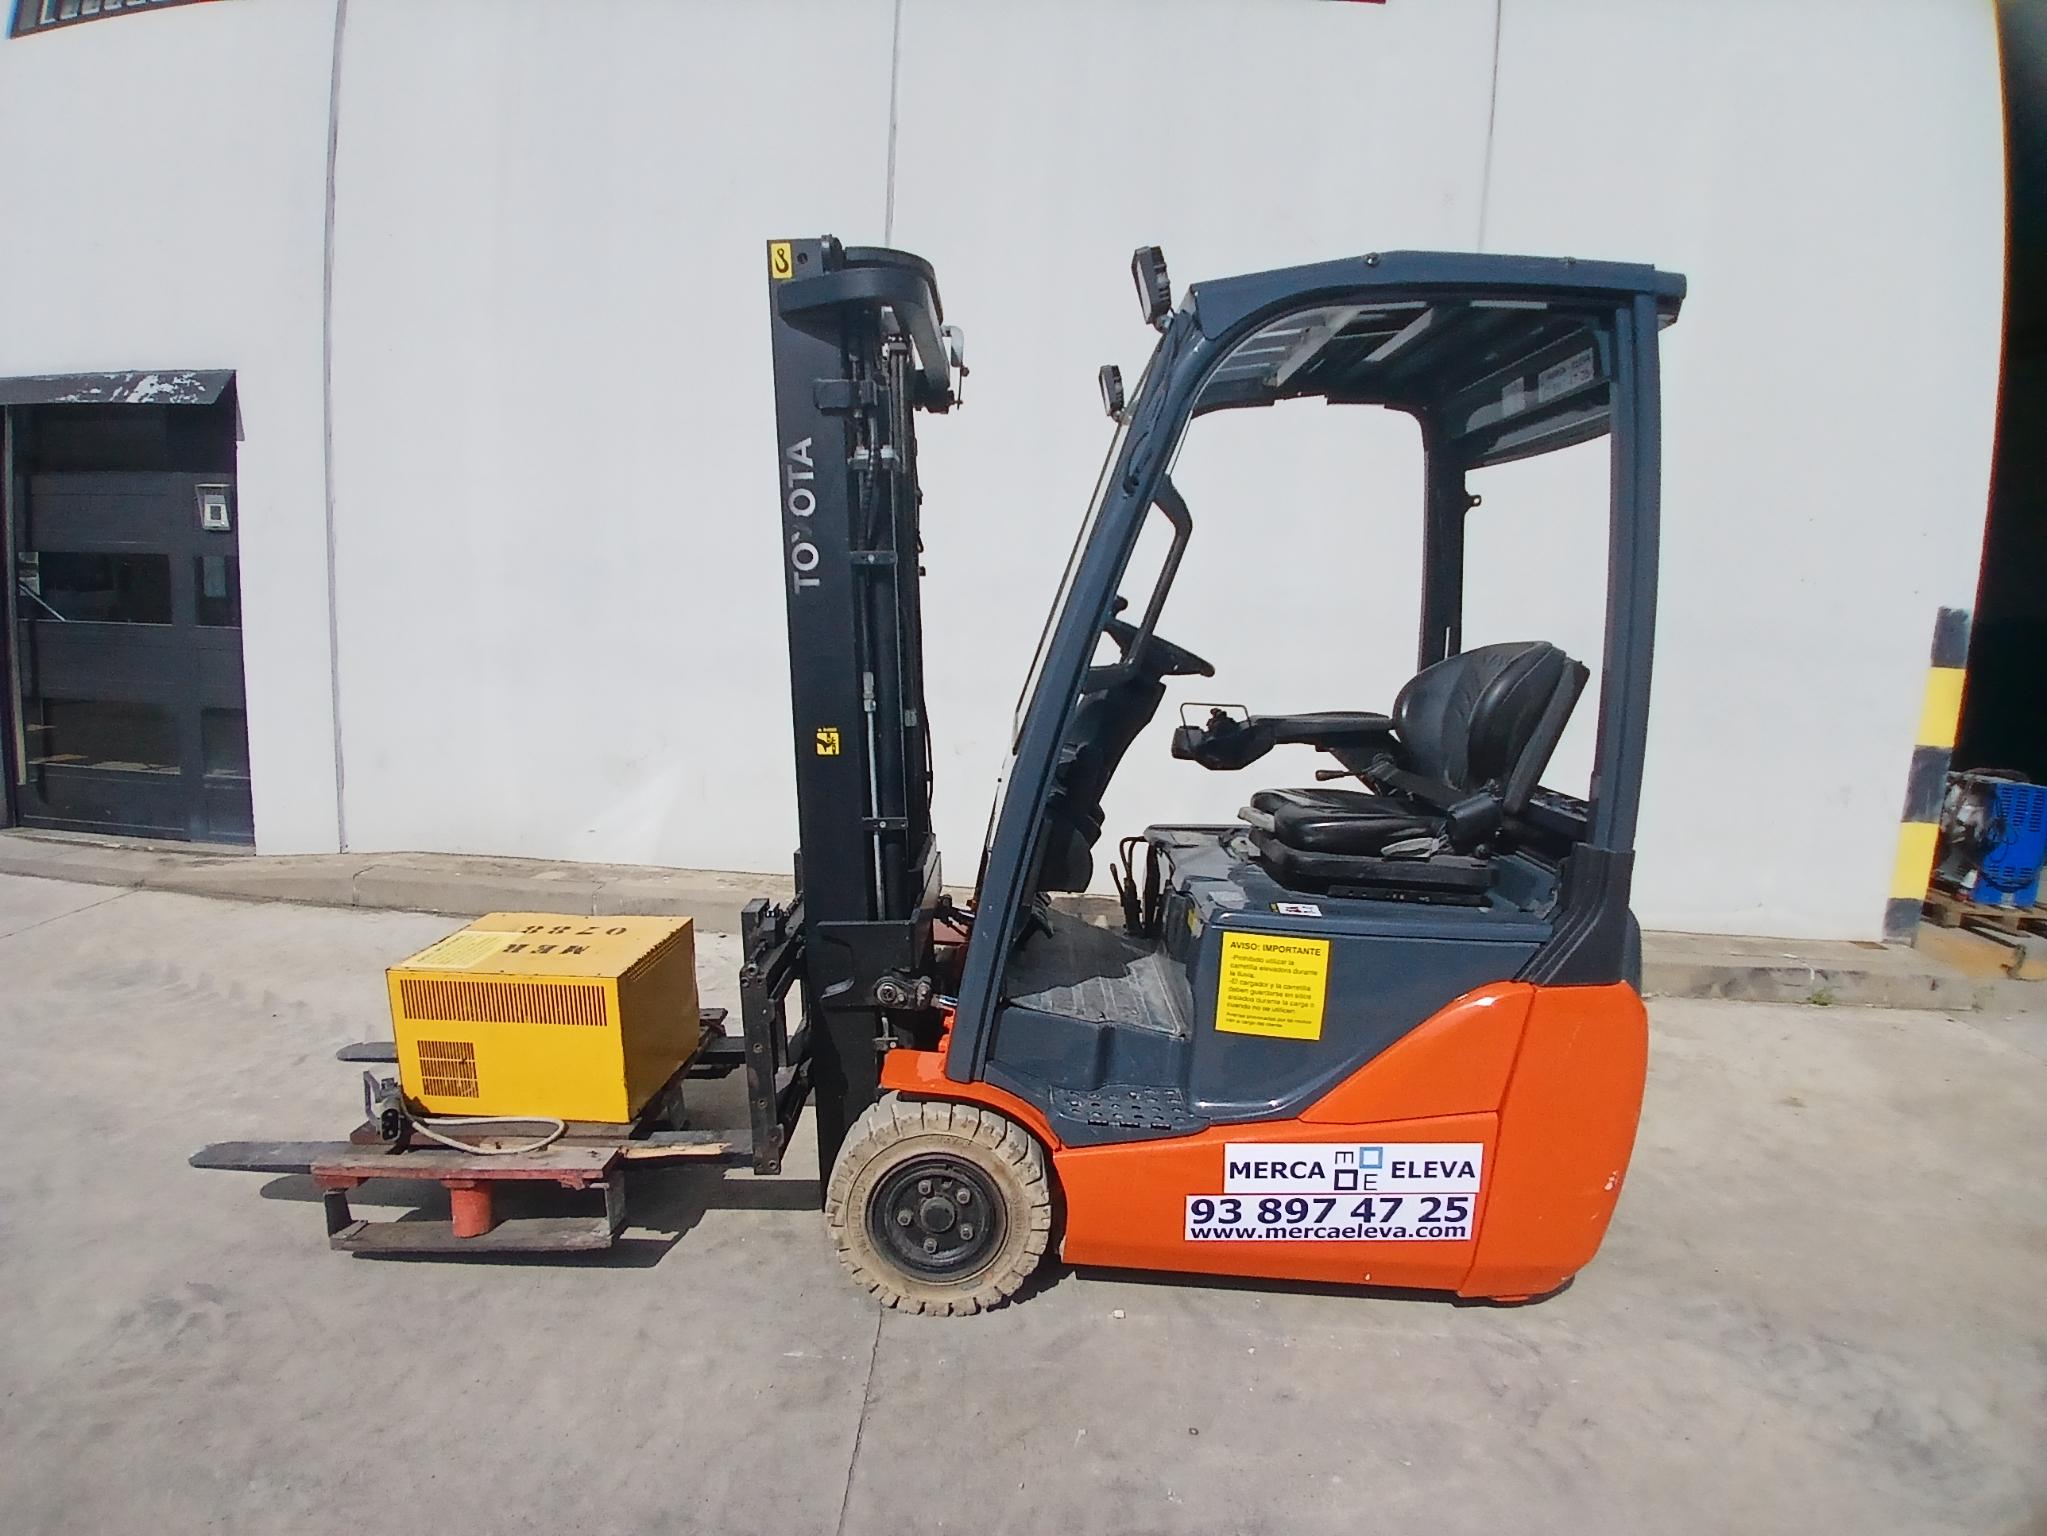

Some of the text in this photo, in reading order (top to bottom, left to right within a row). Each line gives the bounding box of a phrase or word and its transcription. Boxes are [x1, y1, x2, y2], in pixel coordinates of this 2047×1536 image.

[1230, 941, 1320, 956] AVISO: IMPORTANTE
[1229, 1161, 1475, 1179] MERCA ELEVA
[1191, 1197, 1468, 1224] 93 897 47 25
[1191, 1224, 1466, 1238] www.mercaeleva.com
